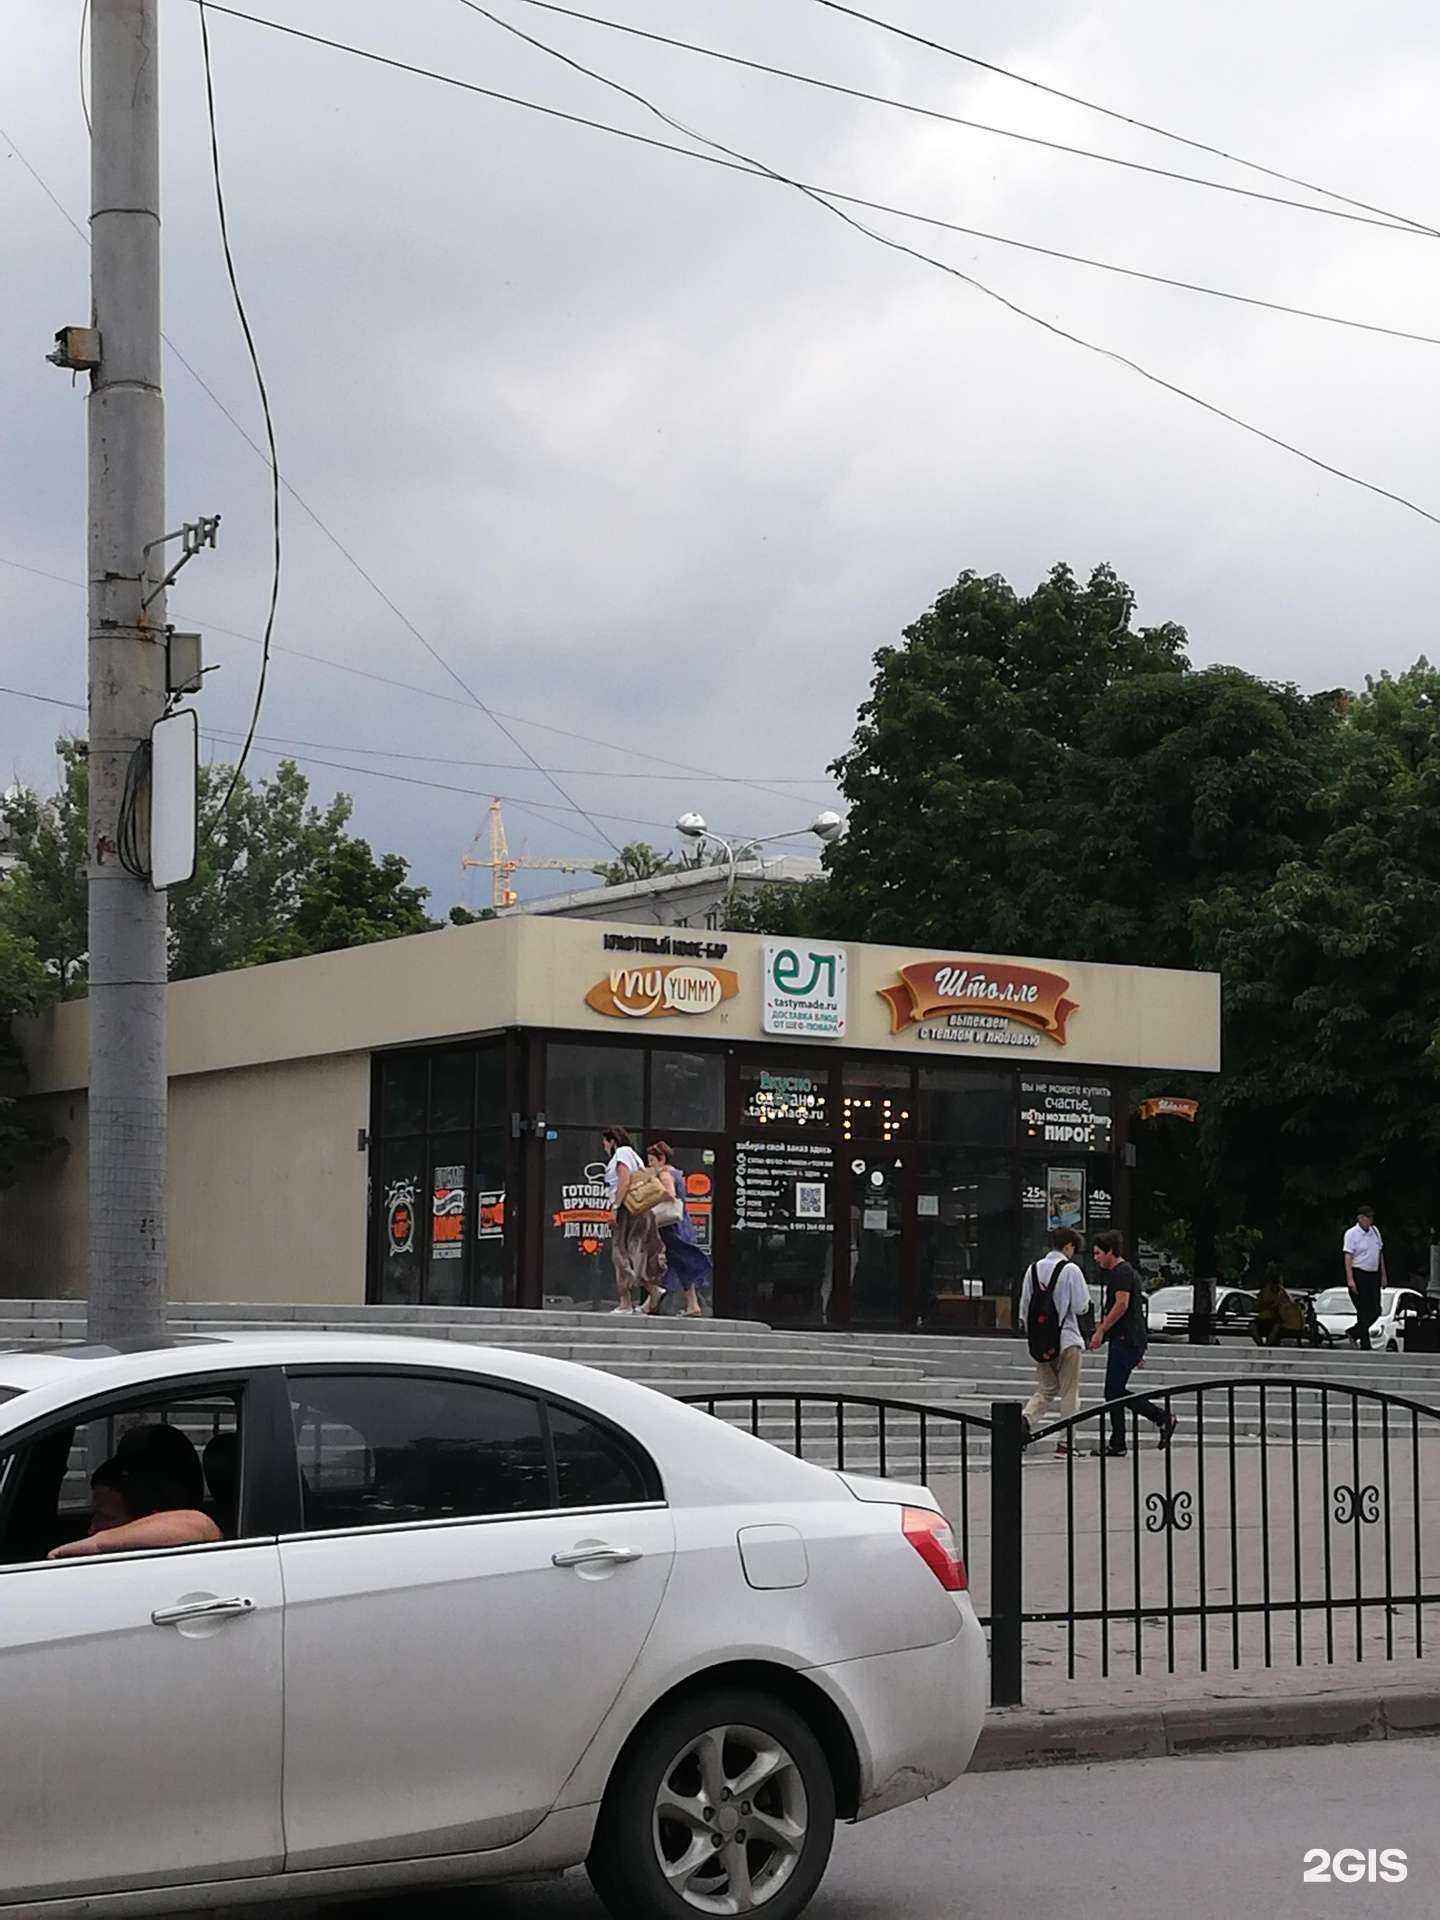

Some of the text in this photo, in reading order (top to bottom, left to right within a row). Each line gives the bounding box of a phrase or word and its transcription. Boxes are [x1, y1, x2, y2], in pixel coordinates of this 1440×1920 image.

[669, 976, 718, 1002] YUMMY
[934, 966, 1040, 1003] Штолле
[773, 998, 838, 1011] tastymade.ru
[948, 1014, 1009, 1030] выпекаем
[931, 1027, 974, 1042] теплом
[562, 1183, 611, 1198] ГОТОВИ
